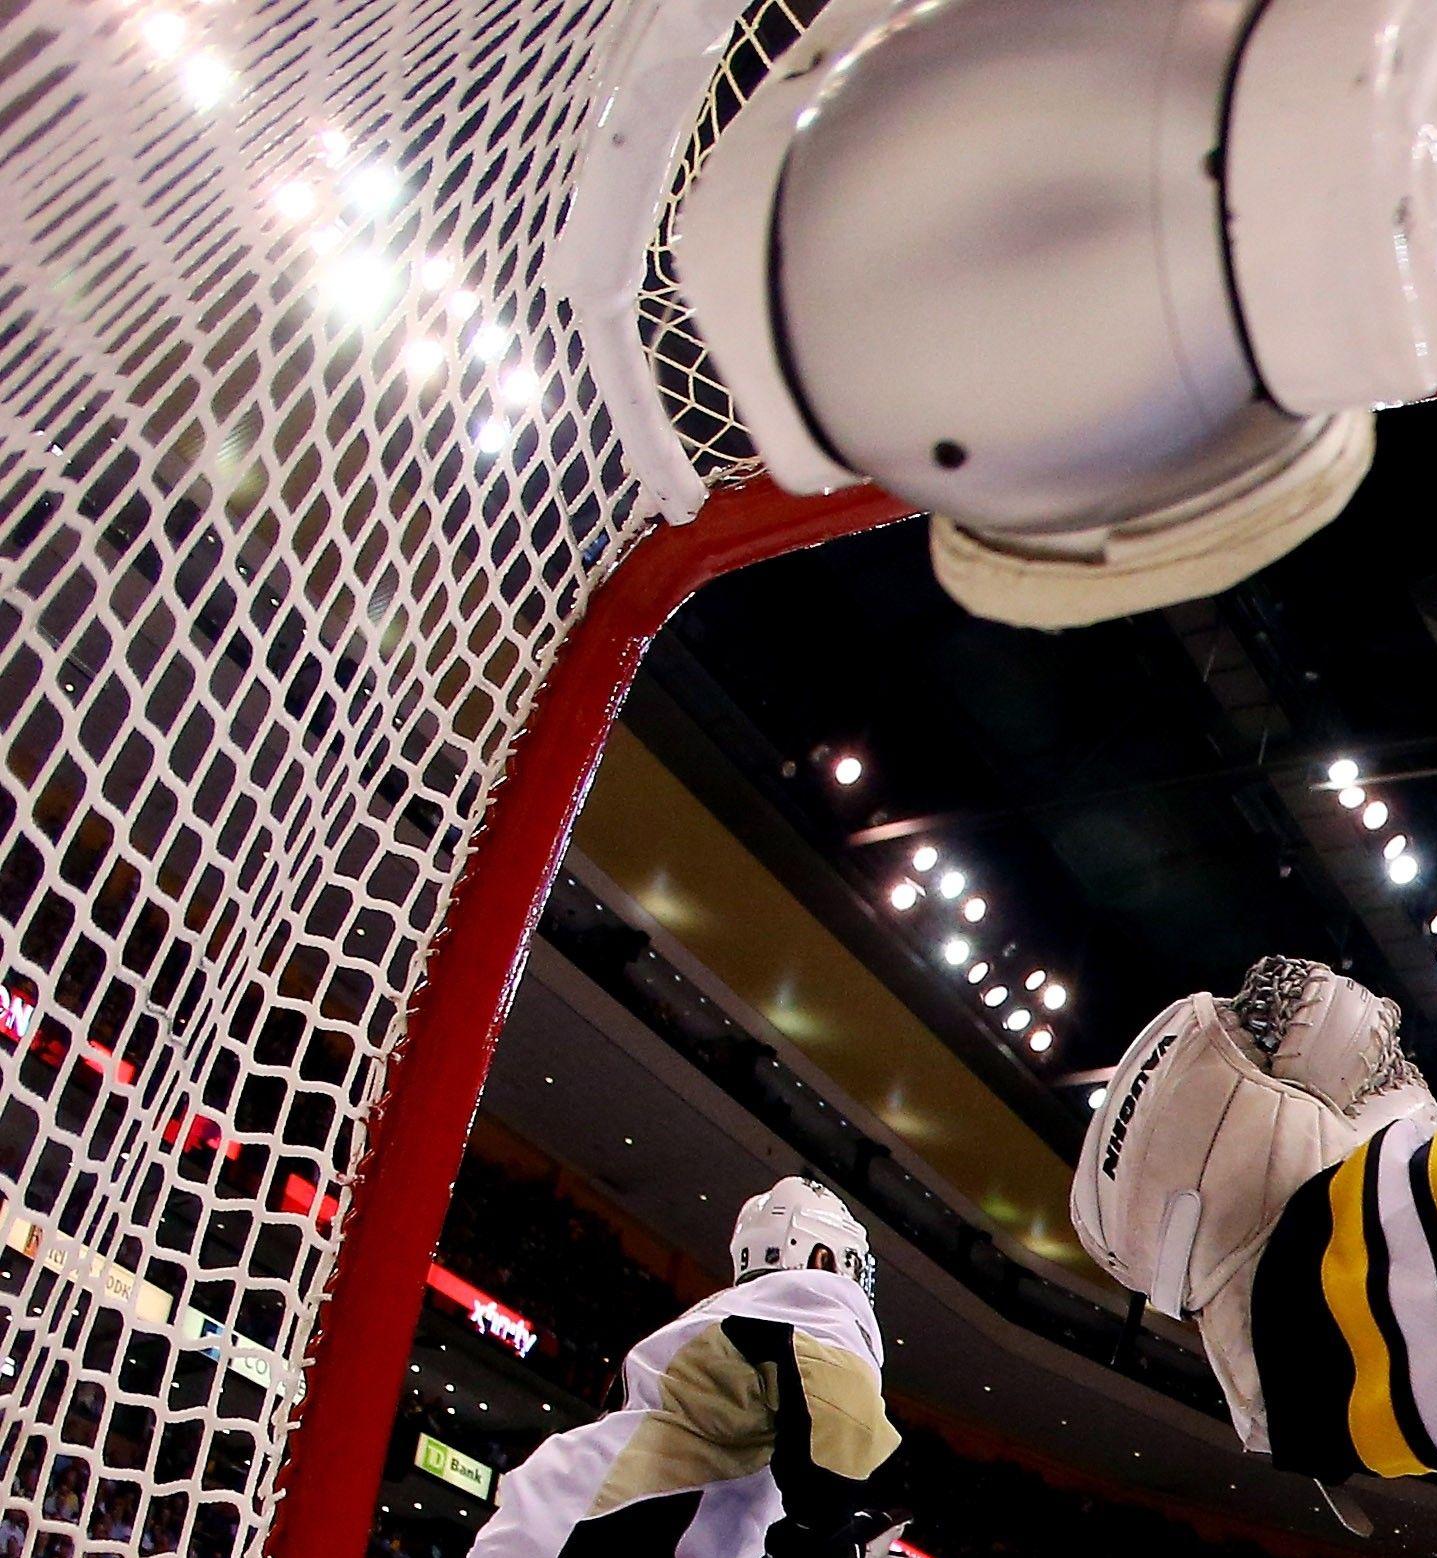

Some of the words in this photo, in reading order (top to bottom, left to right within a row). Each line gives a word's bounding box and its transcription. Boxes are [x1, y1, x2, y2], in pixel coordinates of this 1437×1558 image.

[1102, 1034, 1178, 1182] VAUGHN
[470, 1298, 538, 1359] xfinity
[450, 1454, 482, 1485] Bank
